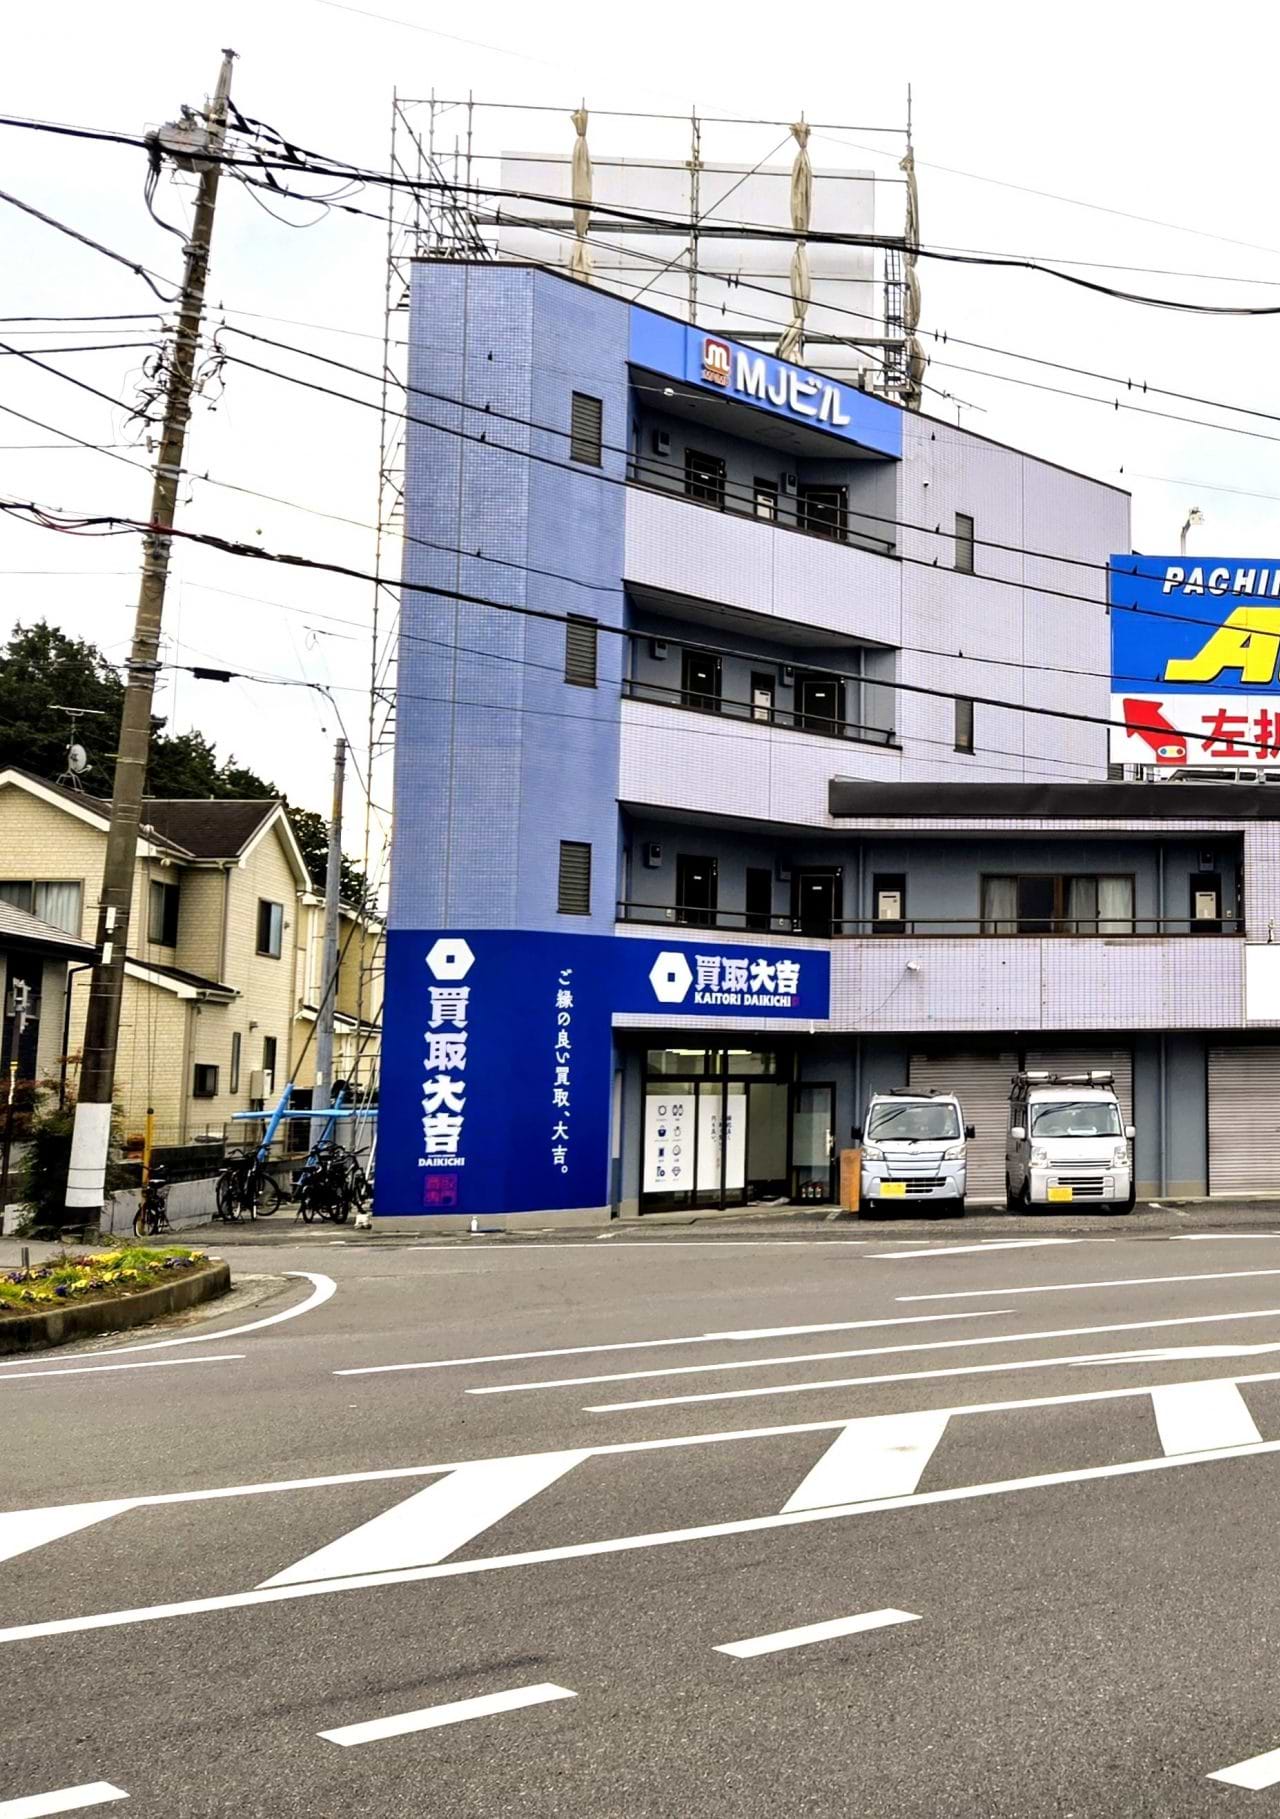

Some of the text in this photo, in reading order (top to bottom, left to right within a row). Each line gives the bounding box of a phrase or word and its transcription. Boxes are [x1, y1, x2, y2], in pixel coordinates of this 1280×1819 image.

[735, 351, 851, 426] MJビル
[694, 955, 801, 994] 買取大吉
[694, 992, 742, 1005] KAITORI
[743, 994, 791, 1008] DAIKICHI
[421, 985, 471, 1154] 買取大吉
[551, 968, 574, 1174] ご縁の良い買取、大吉。
[418, 1157, 465, 1167] DAIKICHI
